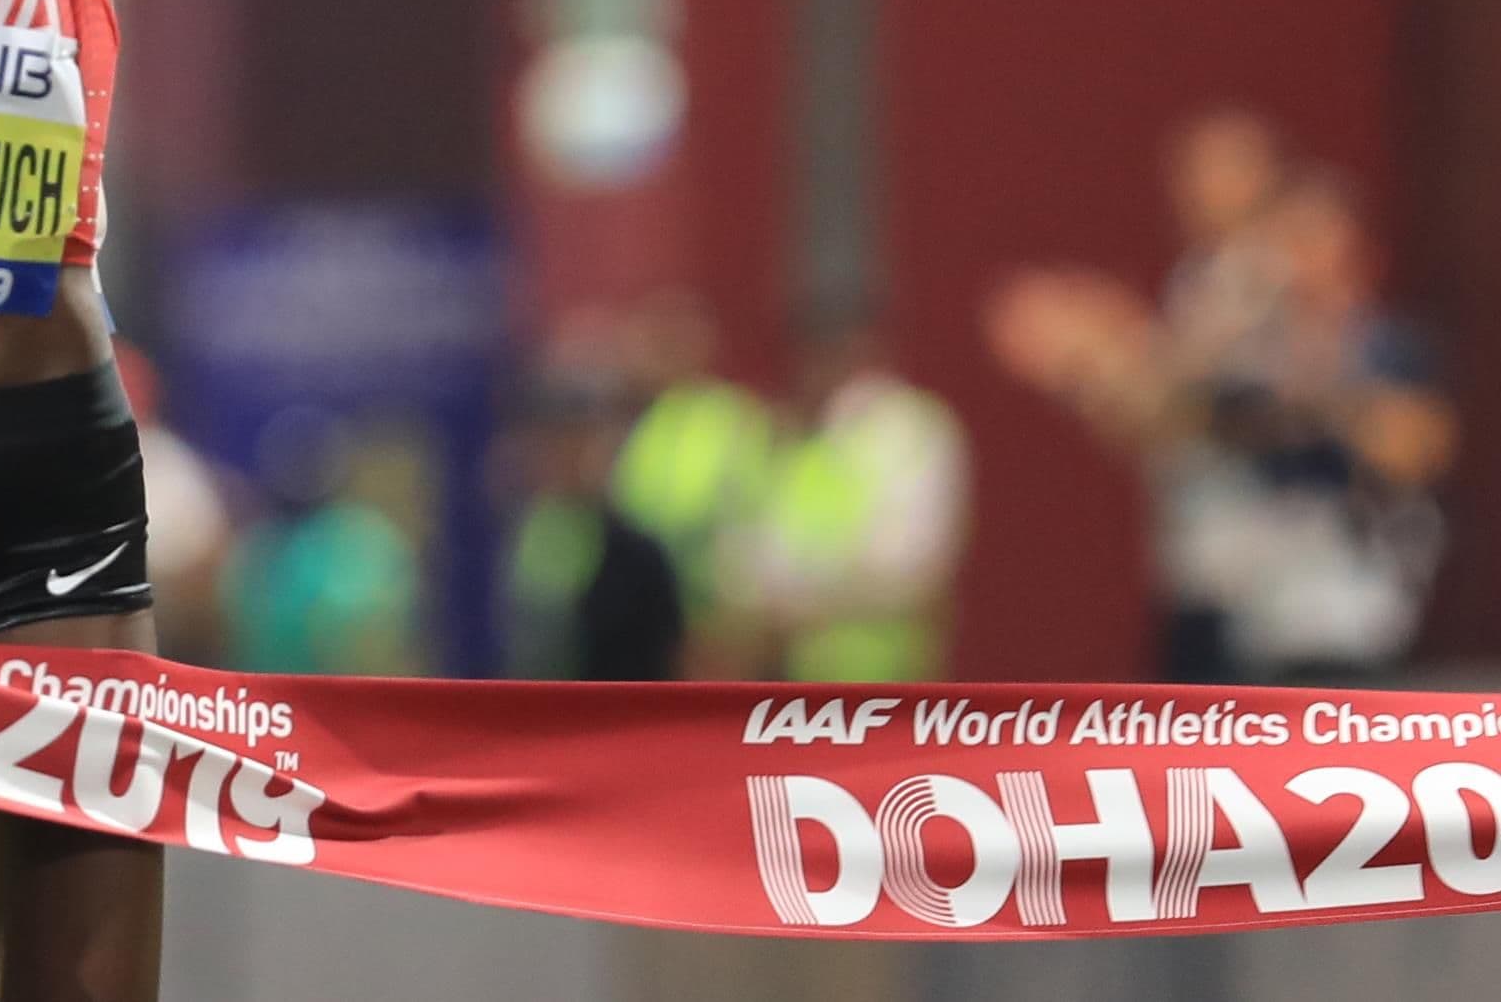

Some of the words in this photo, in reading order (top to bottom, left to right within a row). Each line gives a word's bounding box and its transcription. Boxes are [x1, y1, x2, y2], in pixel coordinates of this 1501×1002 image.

[742, 697, 902, 746] IAAF
[912, 698, 1064, 746] World
[1068, 699, 1290, 747] Athletics
[1302, 701, 1501, 748] Champi
